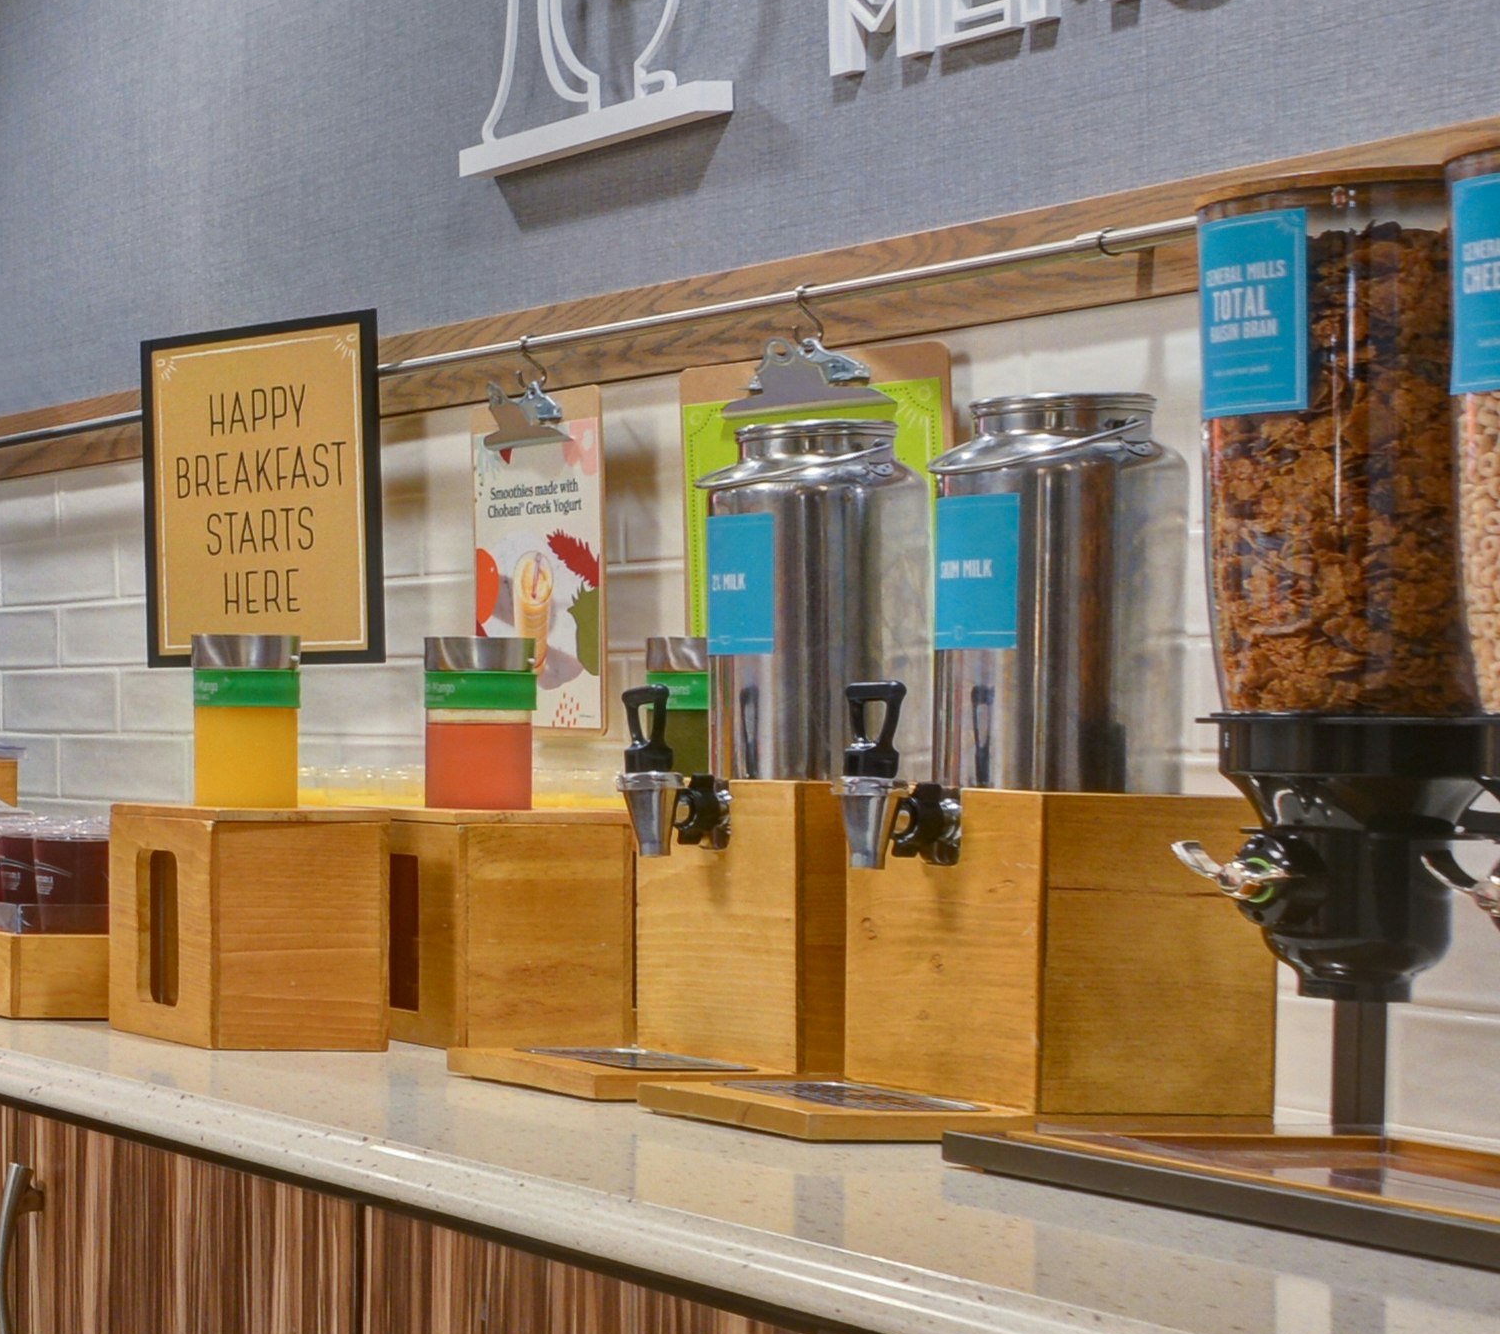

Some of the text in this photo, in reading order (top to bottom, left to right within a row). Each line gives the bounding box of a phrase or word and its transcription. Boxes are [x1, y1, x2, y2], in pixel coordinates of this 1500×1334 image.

[1206, 259, 1286, 287] GENERAL MILLS
[1212, 285, 1271, 322] TOTAL
[1243, 318, 1278, 339] BRAN
[209, 384, 306, 437] HAPPY
[176, 441, 347, 499] BREAKFAST
[490, 478, 579, 501] Smoothies made with
[526, 500, 552, 515] Greek
[553, 497, 582, 516] Yogurt
[206, 506, 314, 556] STARTS
[723, 573, 747, 591] MILK
[963, 559, 993, 578] MILK
[224, 569, 301, 615] HERE
